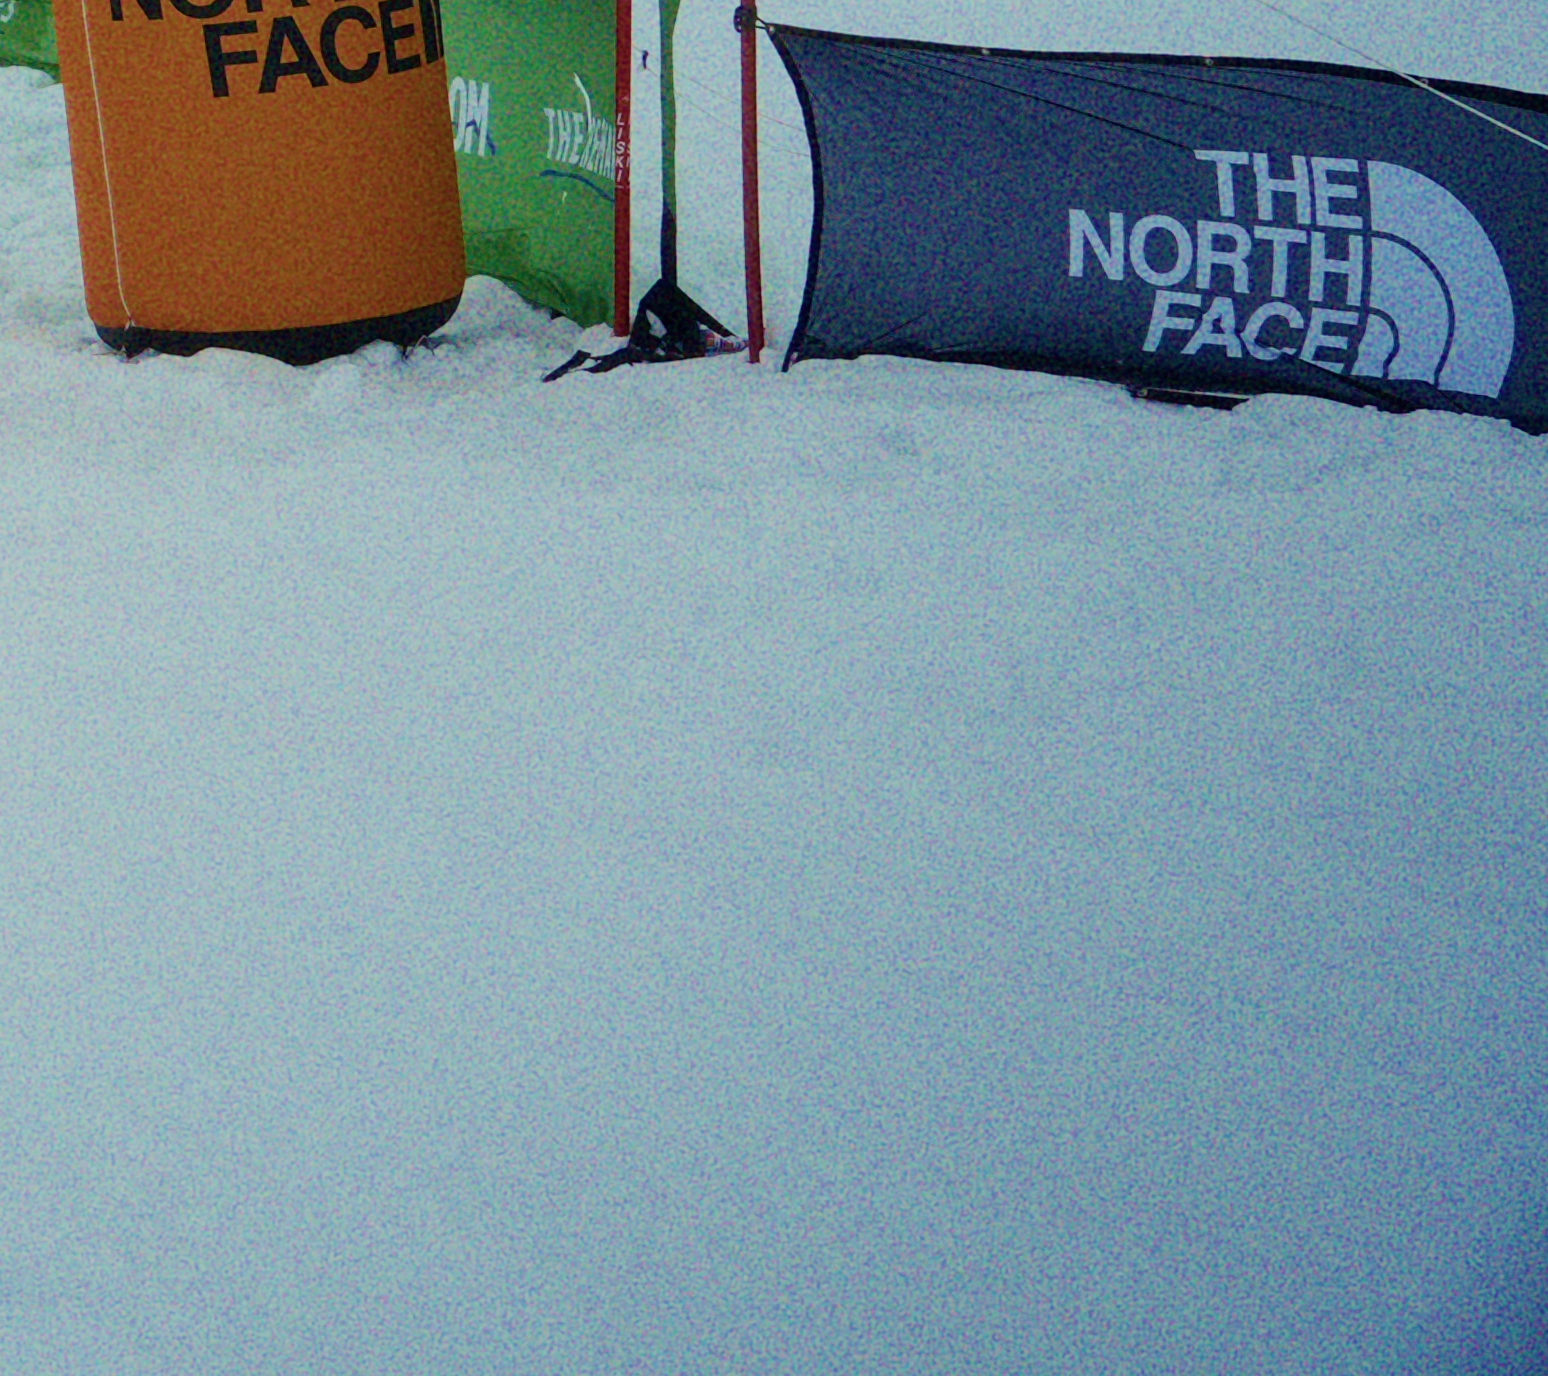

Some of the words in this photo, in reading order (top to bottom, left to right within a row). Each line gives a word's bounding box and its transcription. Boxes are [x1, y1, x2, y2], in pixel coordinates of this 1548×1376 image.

[543, 107, 584, 165] THE
[616, 112, 627, 183] LISKI
[1193, 149, 1364, 230] THE
[1068, 208, 1364, 307] NORTH
[1142, 290, 1360, 376] FACE
